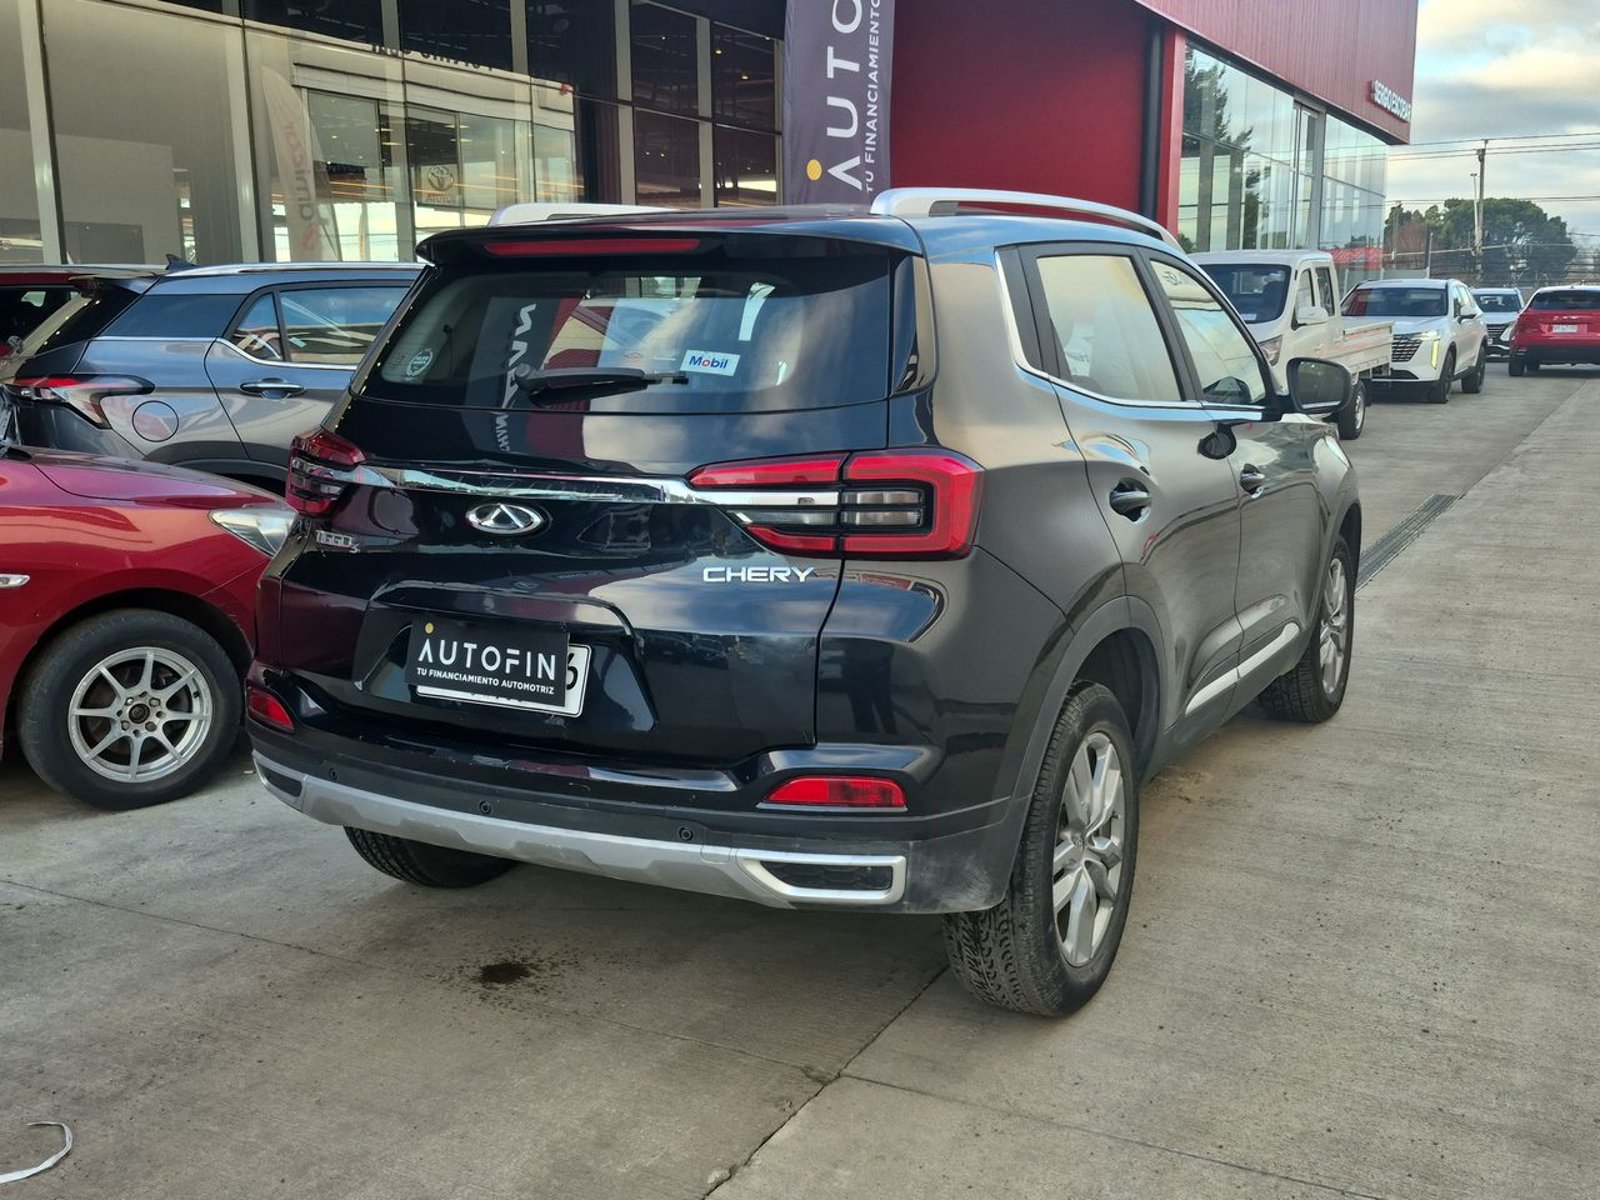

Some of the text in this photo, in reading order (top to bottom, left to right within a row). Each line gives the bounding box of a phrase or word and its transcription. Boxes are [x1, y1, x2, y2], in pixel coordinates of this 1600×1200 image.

[864, 0, 881, 193] TU FINANCIAMIENTO
[689, 355, 728, 369] Mobil
[703, 566, 815, 582] CHERY
[418, 638, 556, 681] AUTOFIN
[416, 667, 555, 695] TU FINANCIAMIENTO AUTOMOTRIZ
